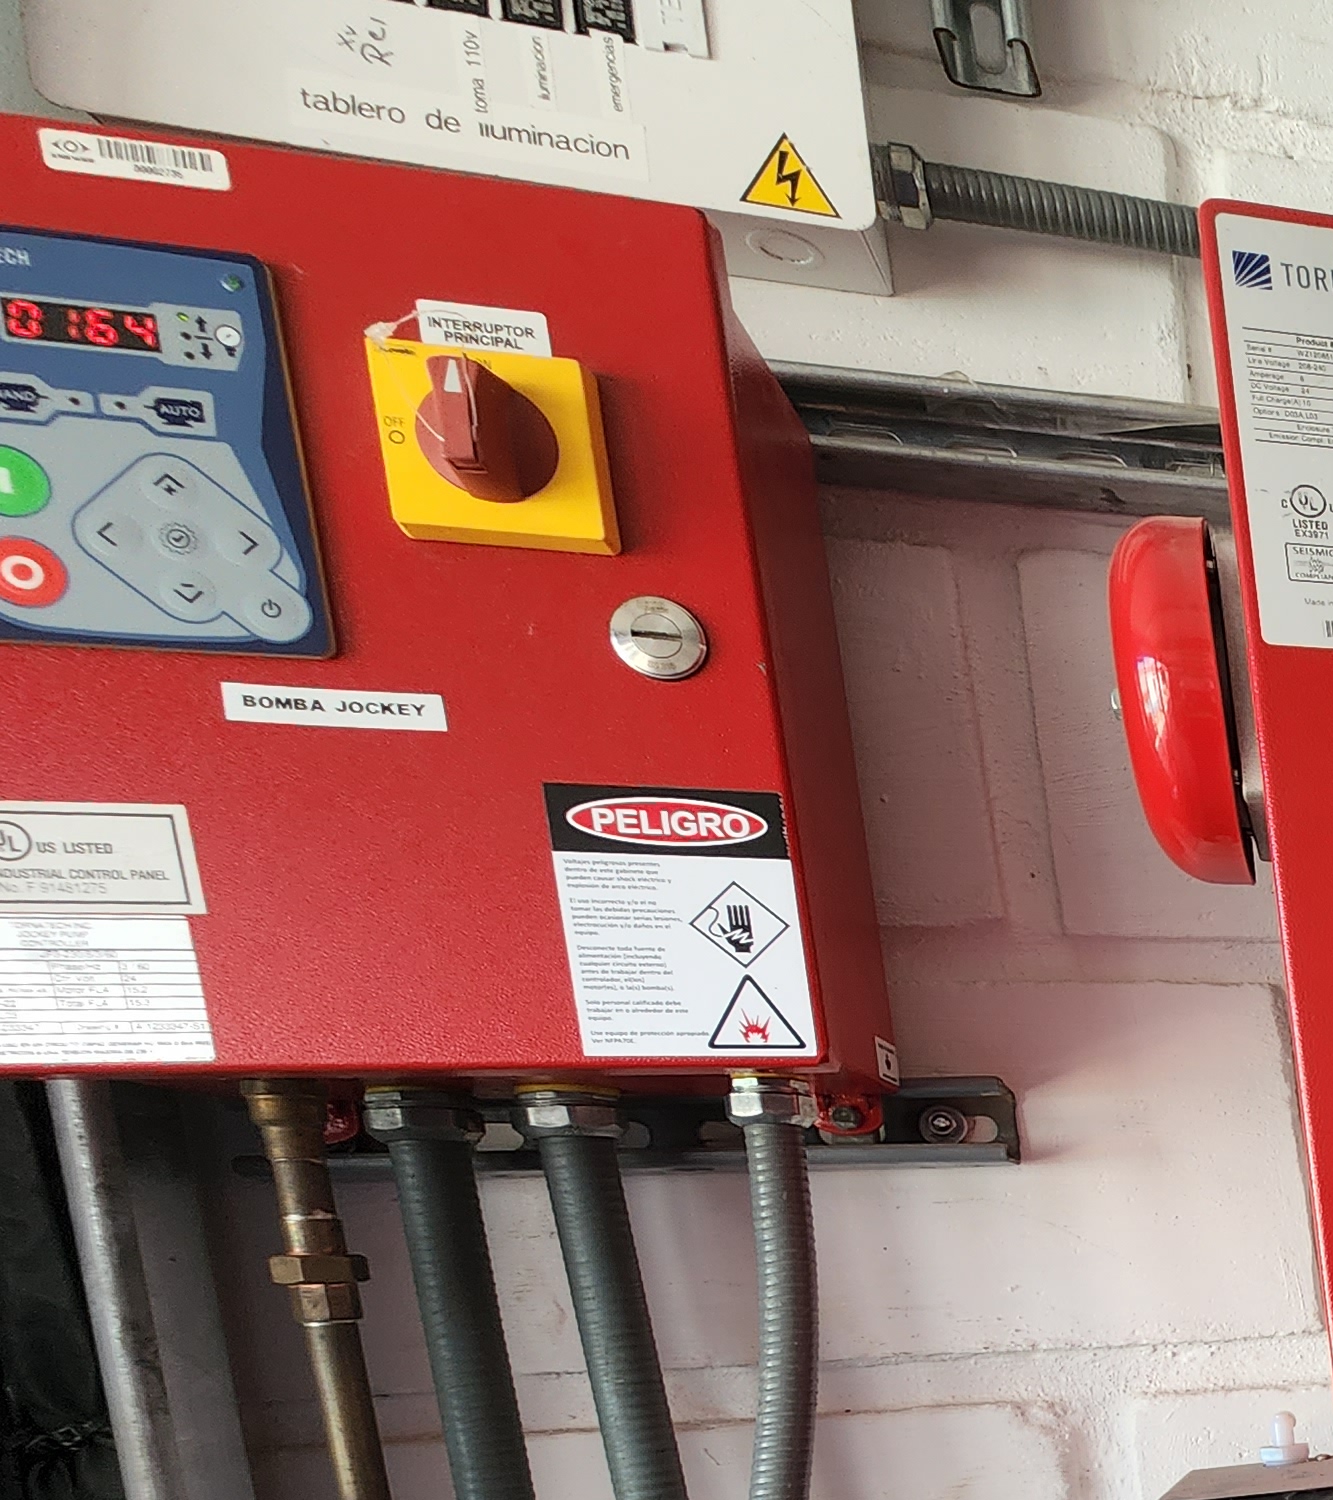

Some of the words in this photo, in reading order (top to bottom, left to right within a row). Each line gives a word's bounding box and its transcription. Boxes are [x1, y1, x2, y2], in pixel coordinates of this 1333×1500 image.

[463, 30, 480, 67] 110v
[603, 37, 624, 113] emergencias
[474, 78, 489, 114] toma
[300, 87, 406, 125] tablero
[425, 109, 461, 134] de
[427, 316, 535, 339] INTERRUPTOR
[444, 330, 524, 350] PRINCIPAL
[158, 404, 201, 418] AUTO
[384, 416, 406, 427] OFF
[1293, 519, 1328, 531] LISTED
[242, 694, 326, 712] BOMBA
[335, 700, 426, 716] JOCKEY
[591, 808, 750, 838] PELIGRO
[63, 842, 113, 854] LISTED
[69, 870, 128, 880] CONTROL
[130, 870, 170, 881] PANEL
